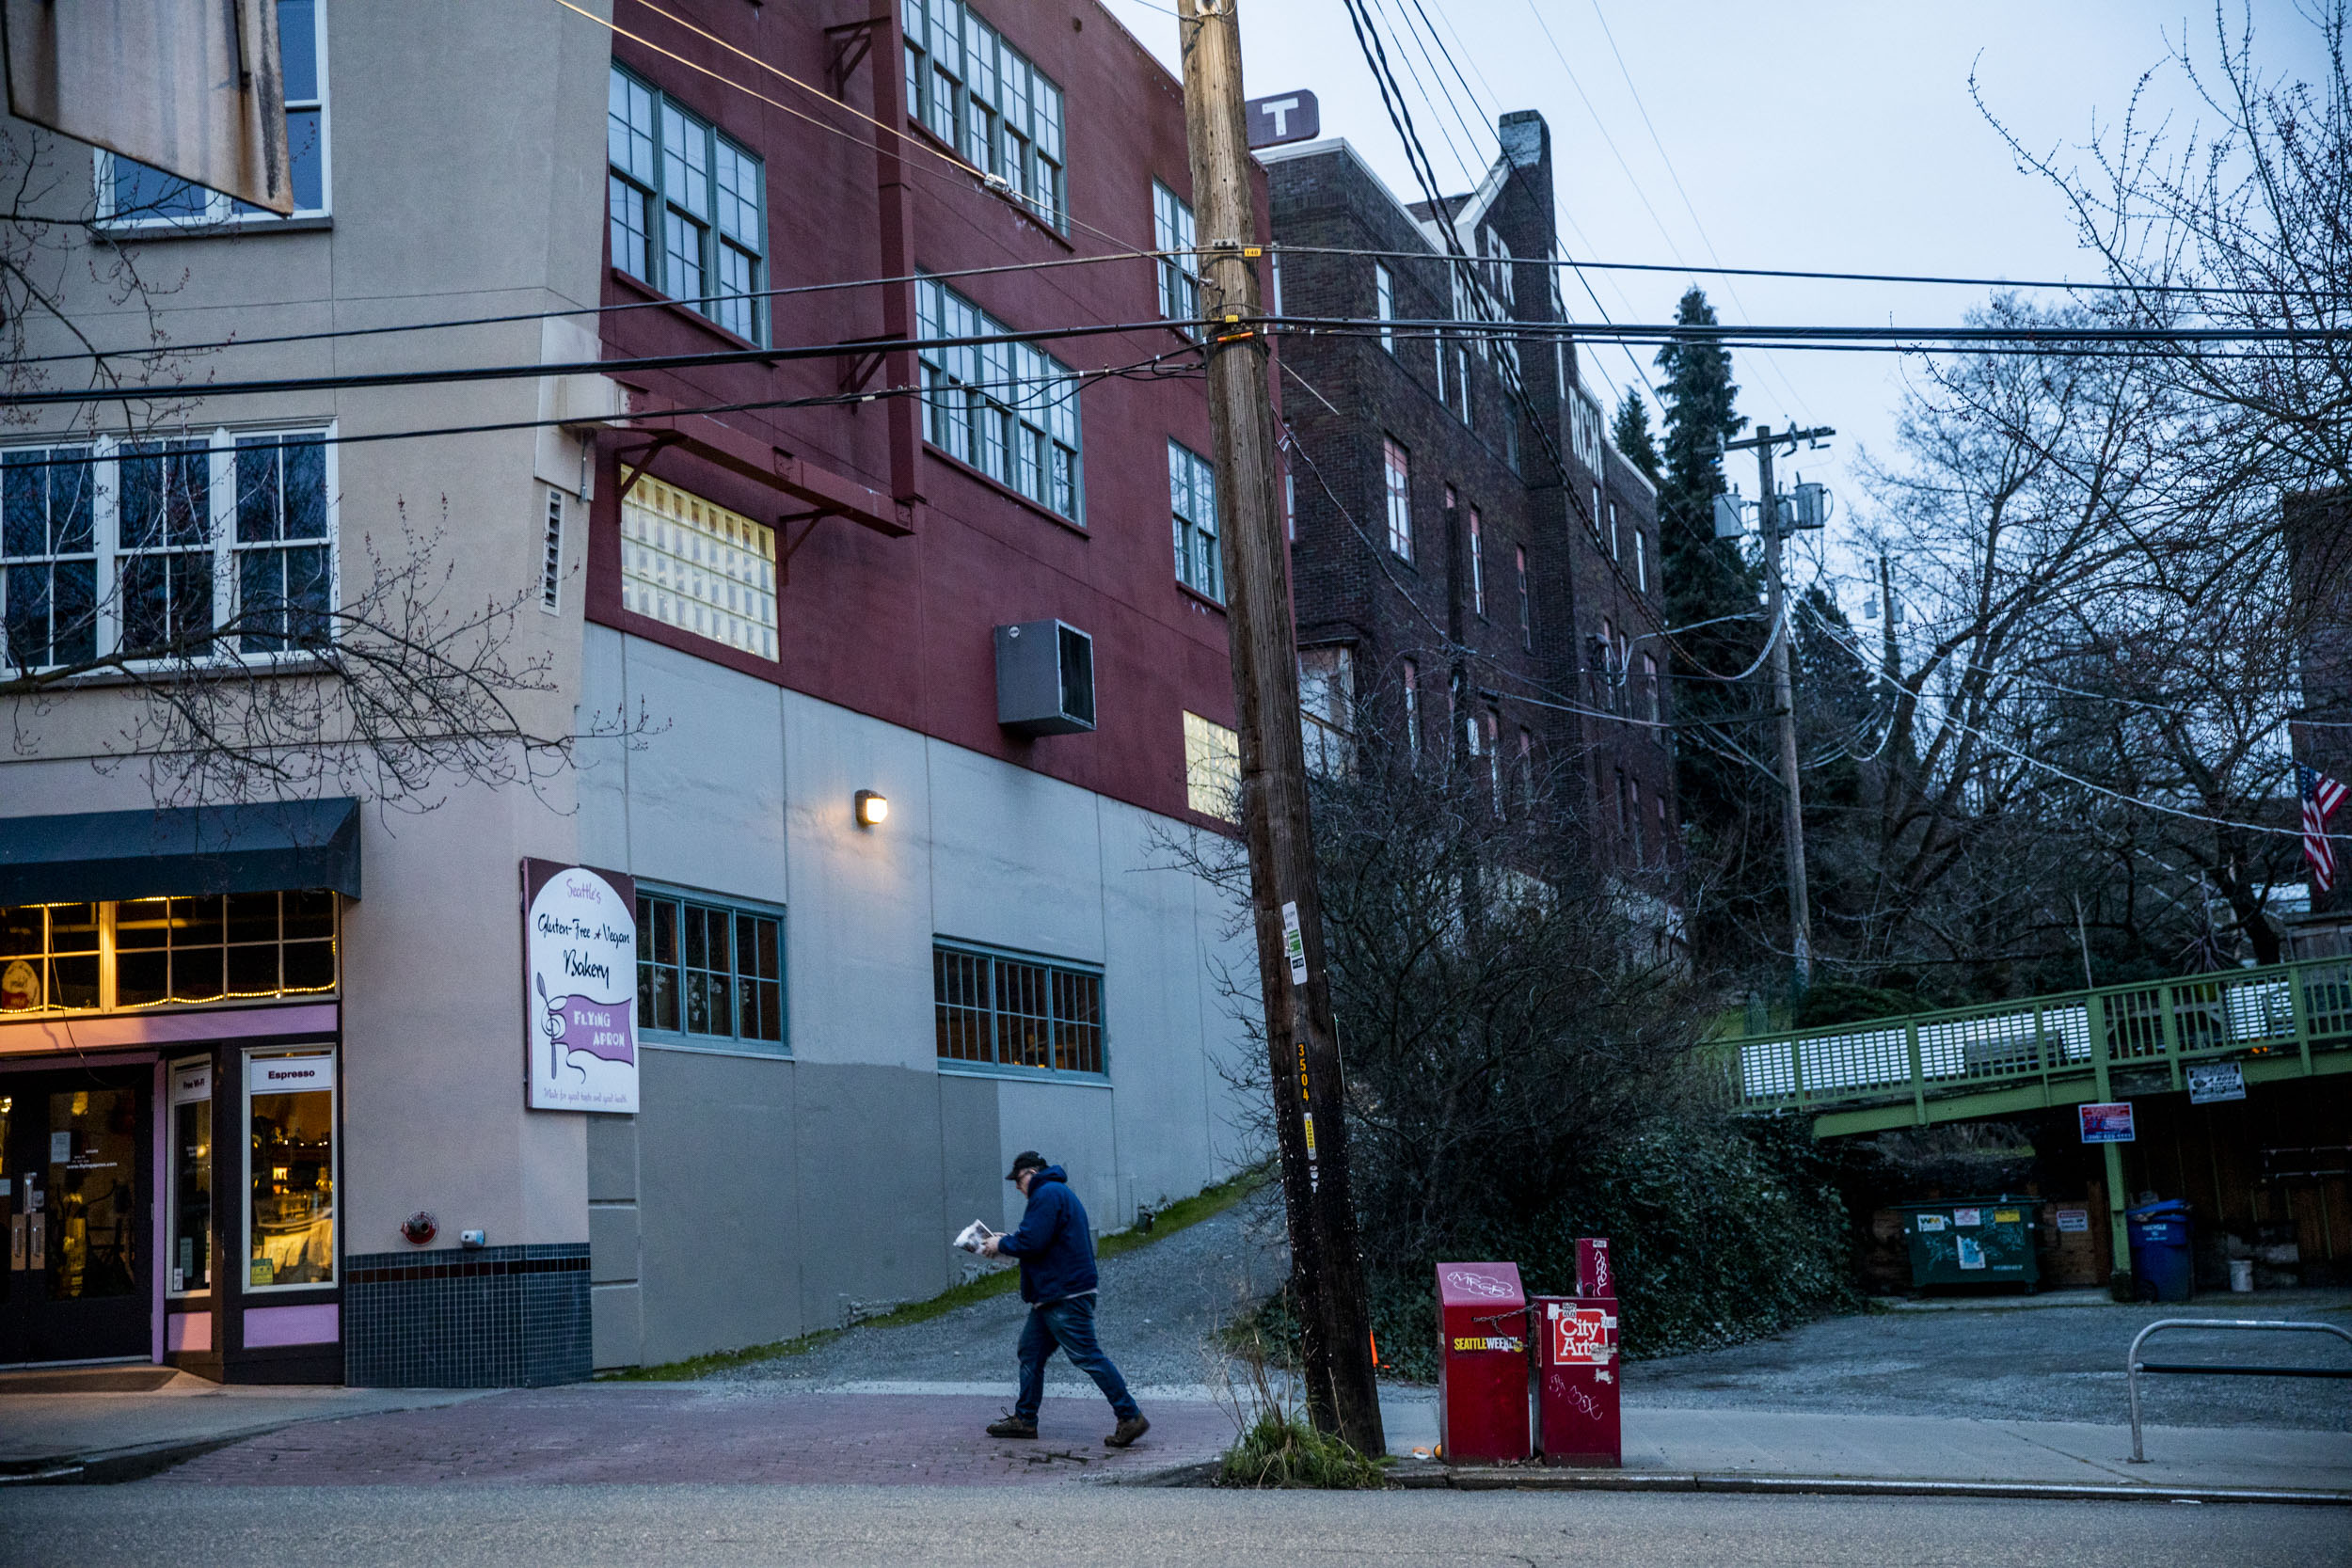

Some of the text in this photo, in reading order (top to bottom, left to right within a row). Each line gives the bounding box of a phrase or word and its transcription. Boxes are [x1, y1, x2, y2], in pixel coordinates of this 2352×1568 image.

[1262, 97, 1299, 137] T
[566, 878, 602, 905] Seattle's
[603, 923, 630, 949] Vegan
[564, 948, 610, 990] Bakery
[573, 1010, 611, 1027] FLYING
[593, 1030, 626, 1047] APRON
[268, 1069, 315, 1081] Espresso
[1560, 1316, 1601, 1341] City
